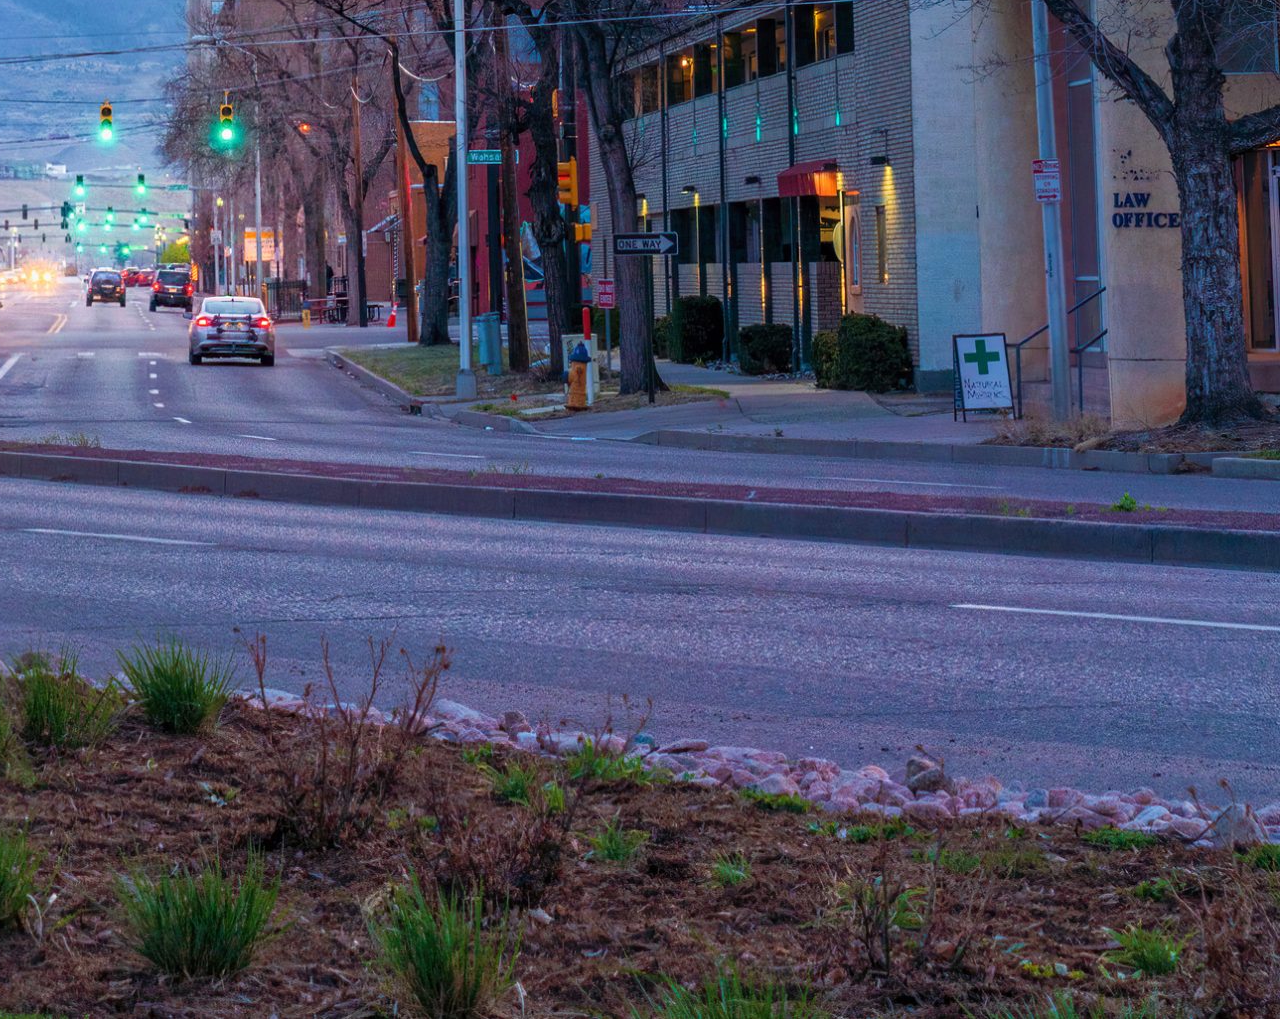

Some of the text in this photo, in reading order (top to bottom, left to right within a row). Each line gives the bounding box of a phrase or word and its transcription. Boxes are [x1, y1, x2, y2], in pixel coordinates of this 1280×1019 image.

[1113, 192, 1151, 208] LAW
[1112, 212, 1180, 228] OFFICE
[619, 239, 661, 249] ONE WAY
